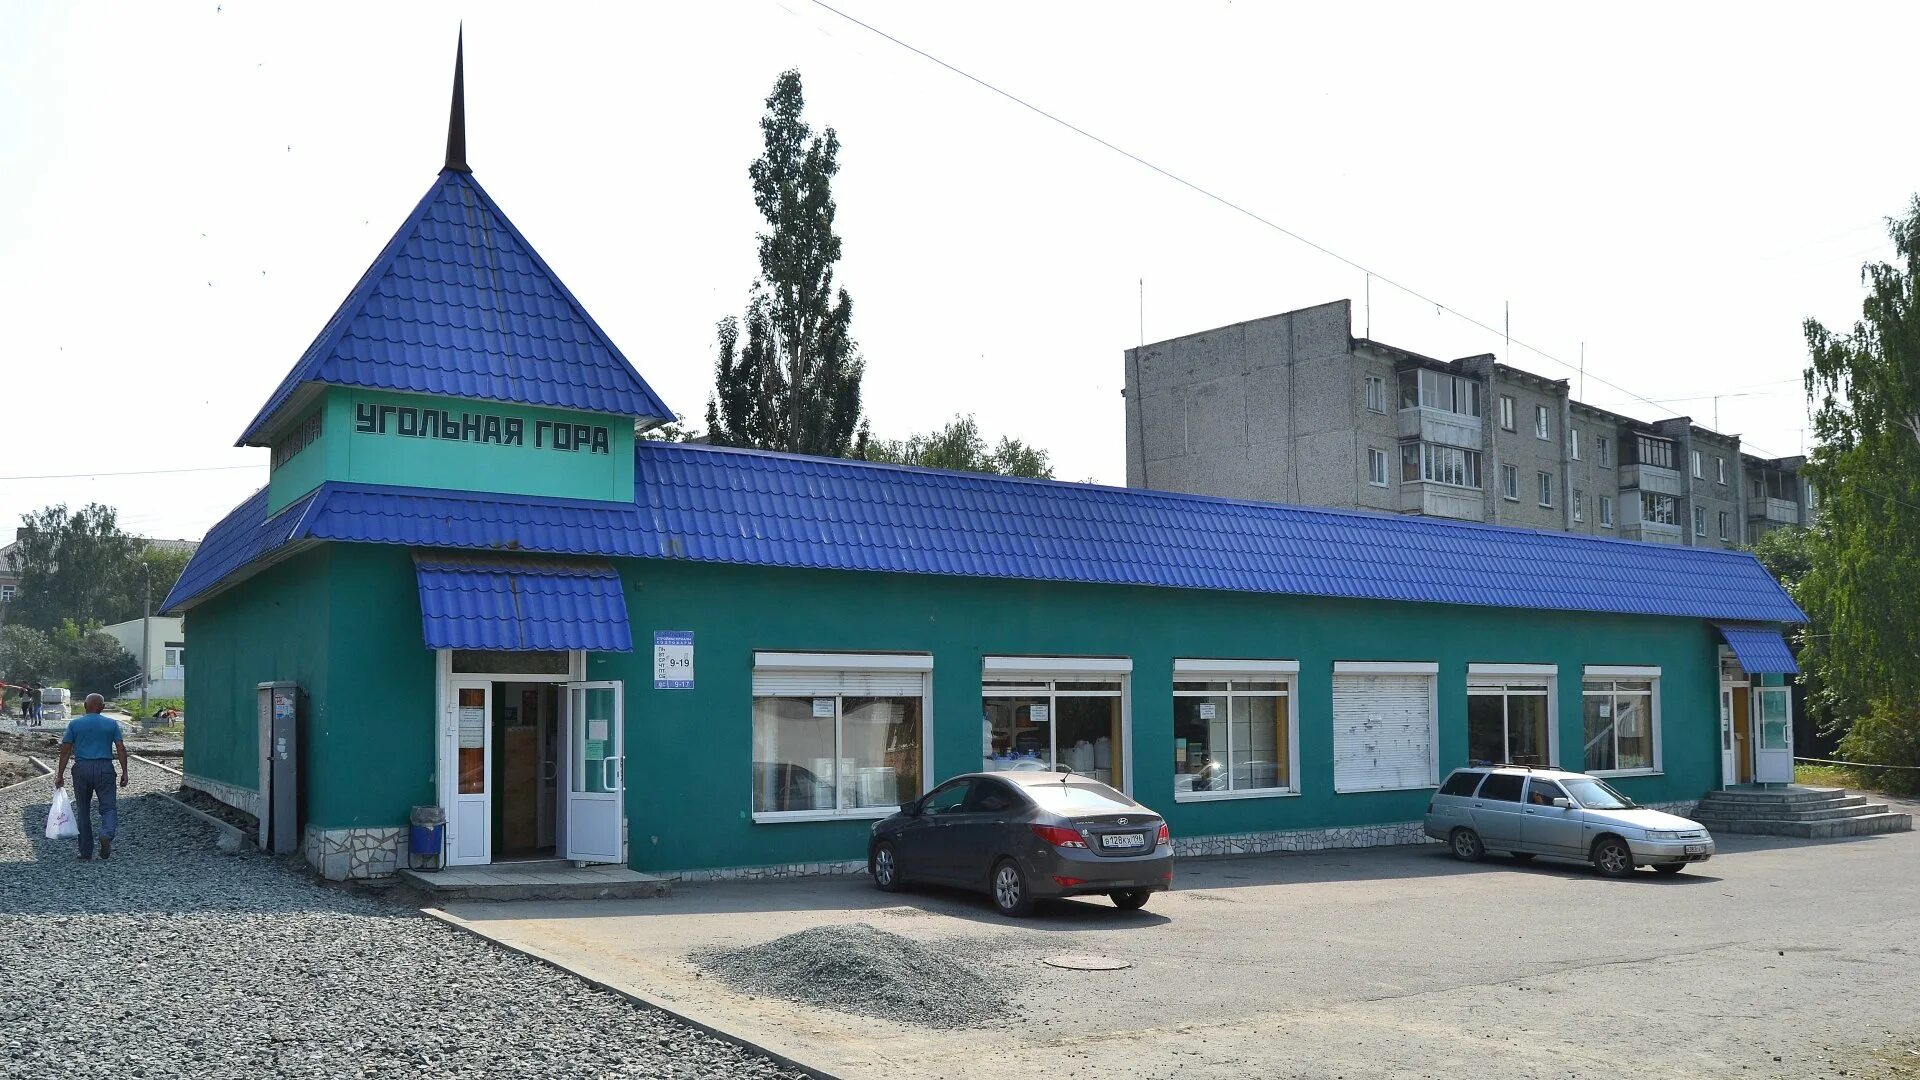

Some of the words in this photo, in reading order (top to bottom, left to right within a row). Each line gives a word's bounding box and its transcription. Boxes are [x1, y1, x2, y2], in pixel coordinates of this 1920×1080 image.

[356, 403, 524, 446] УГОЛЬНАЯ
[534, 419, 609, 455] ГОРА
[670, 659, 689, 667] 9-19
